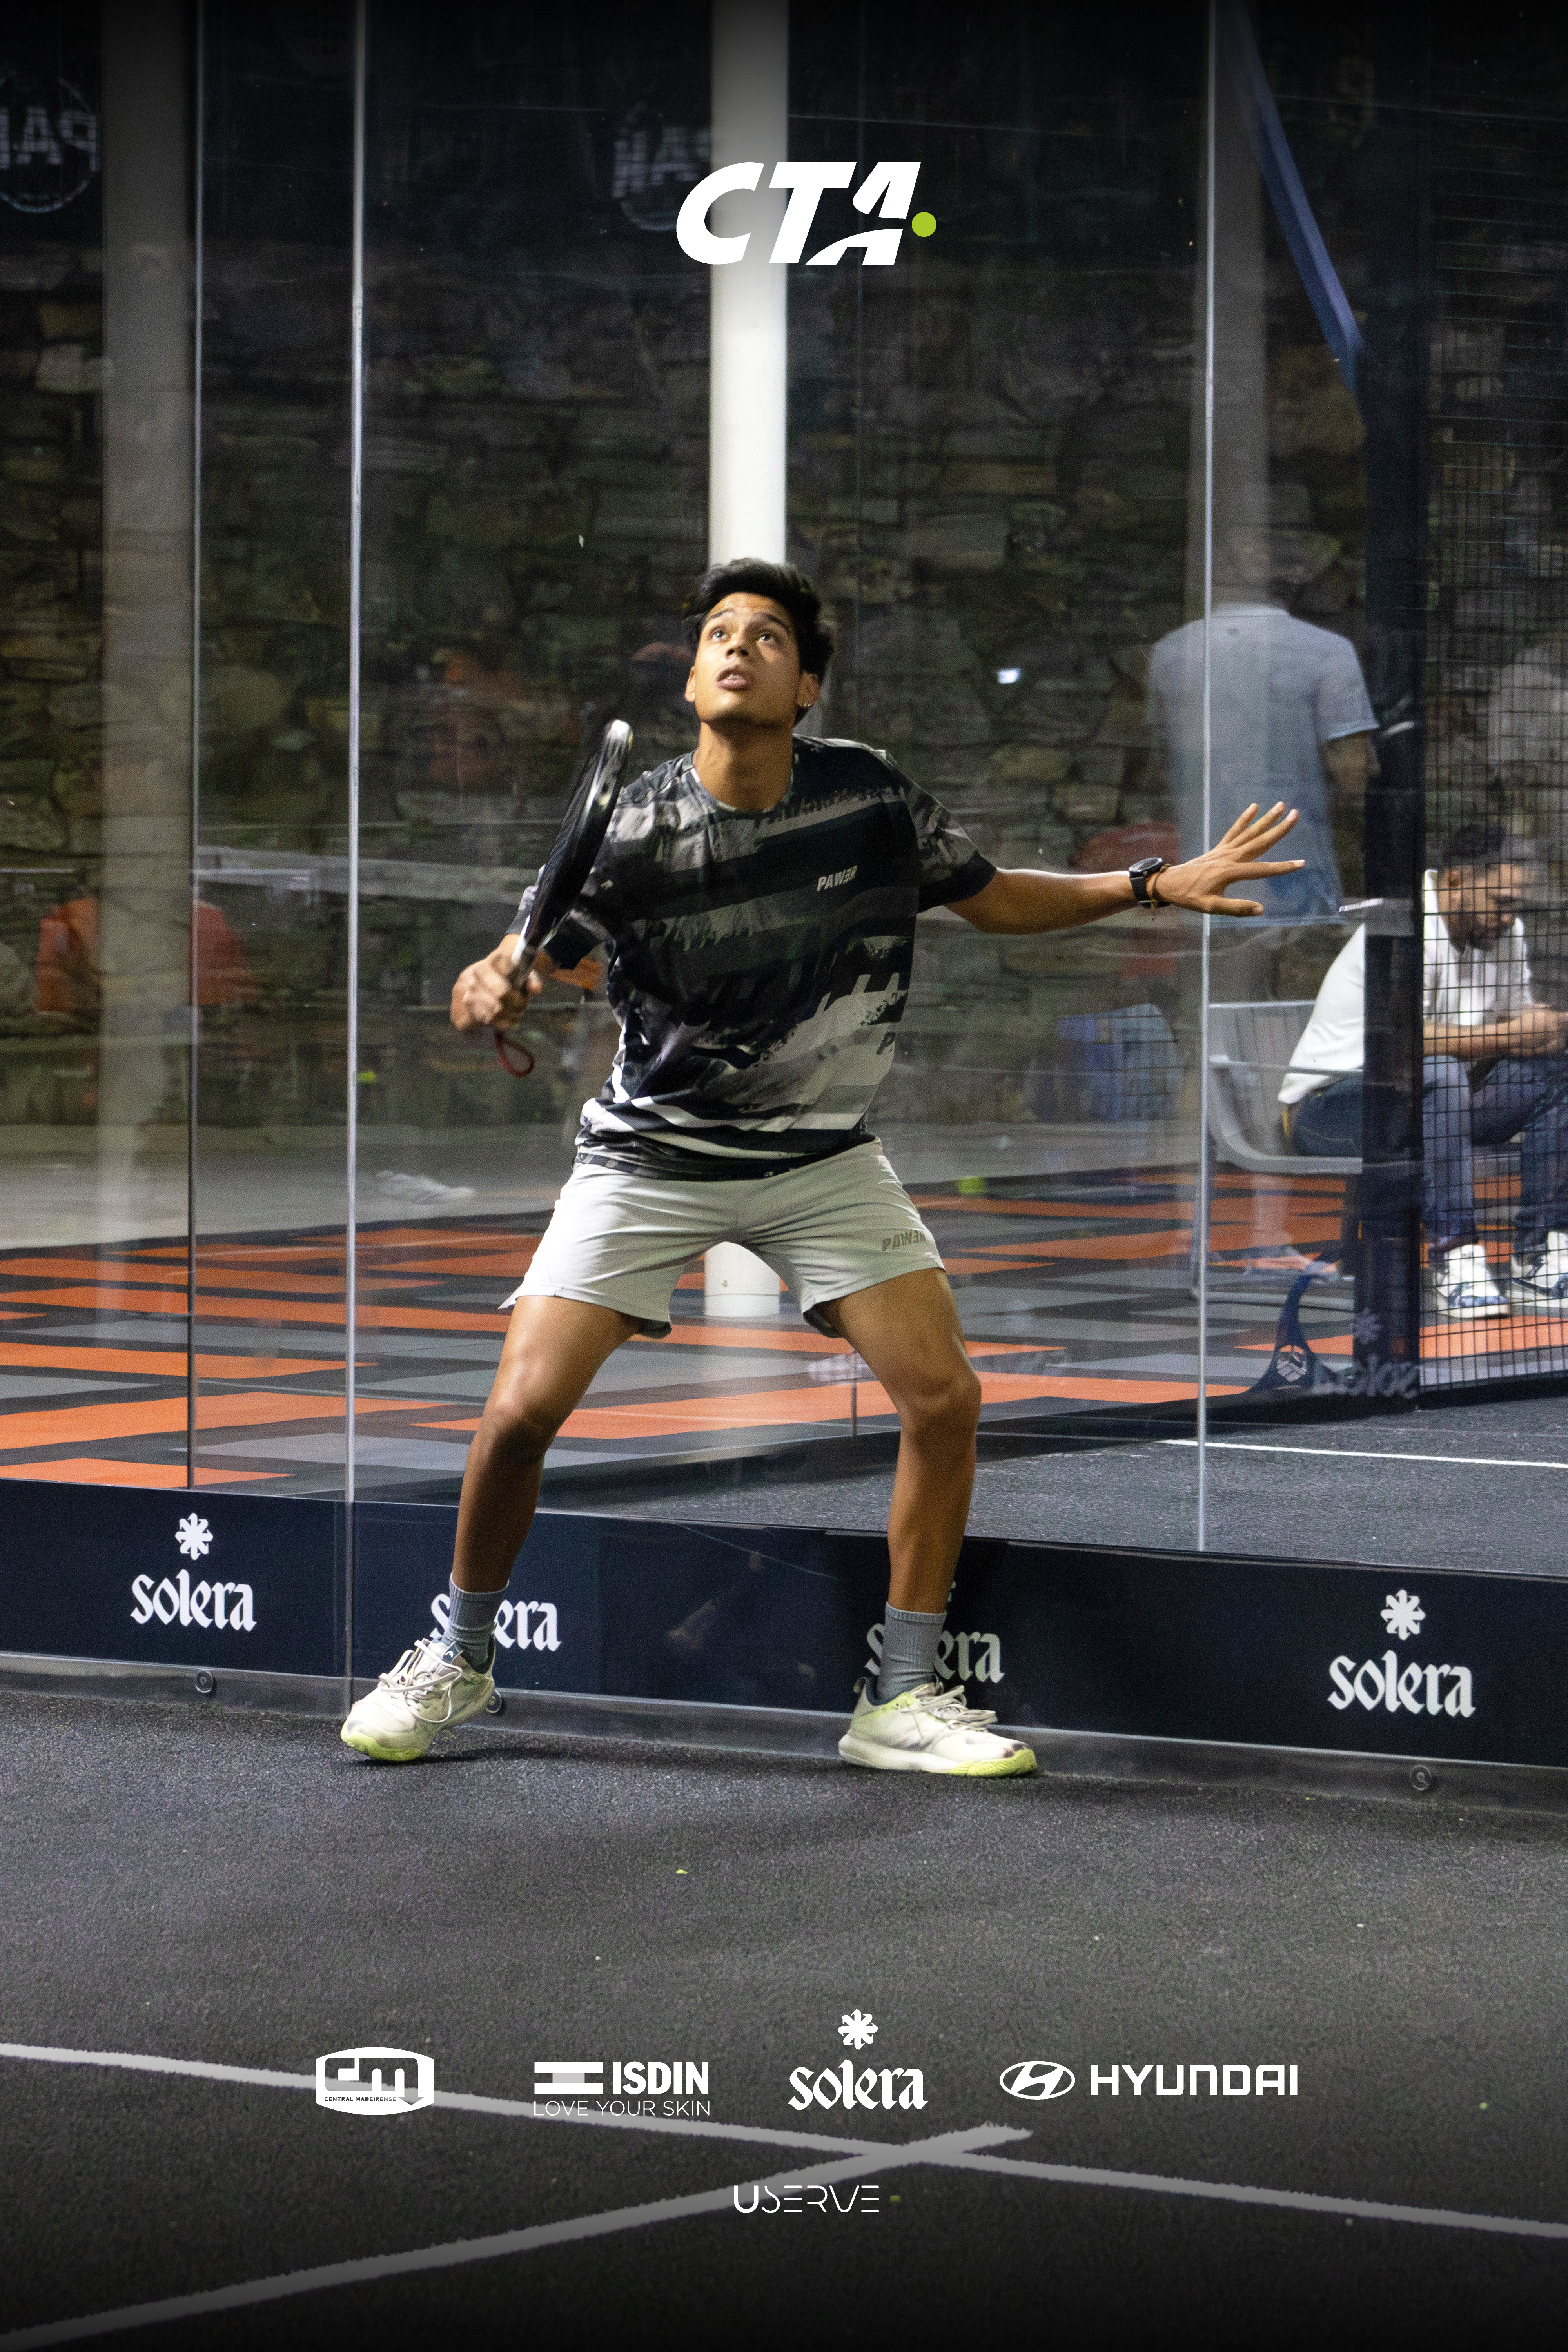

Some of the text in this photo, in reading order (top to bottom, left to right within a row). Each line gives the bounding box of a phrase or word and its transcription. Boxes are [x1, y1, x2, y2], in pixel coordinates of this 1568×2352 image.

[131, 1569, 257, 1632] solera
[430, 1593, 562, 1651] sera
[864, 1623, 1005, 1684] sera
[1328, 1650, 1476, 1718] solera
